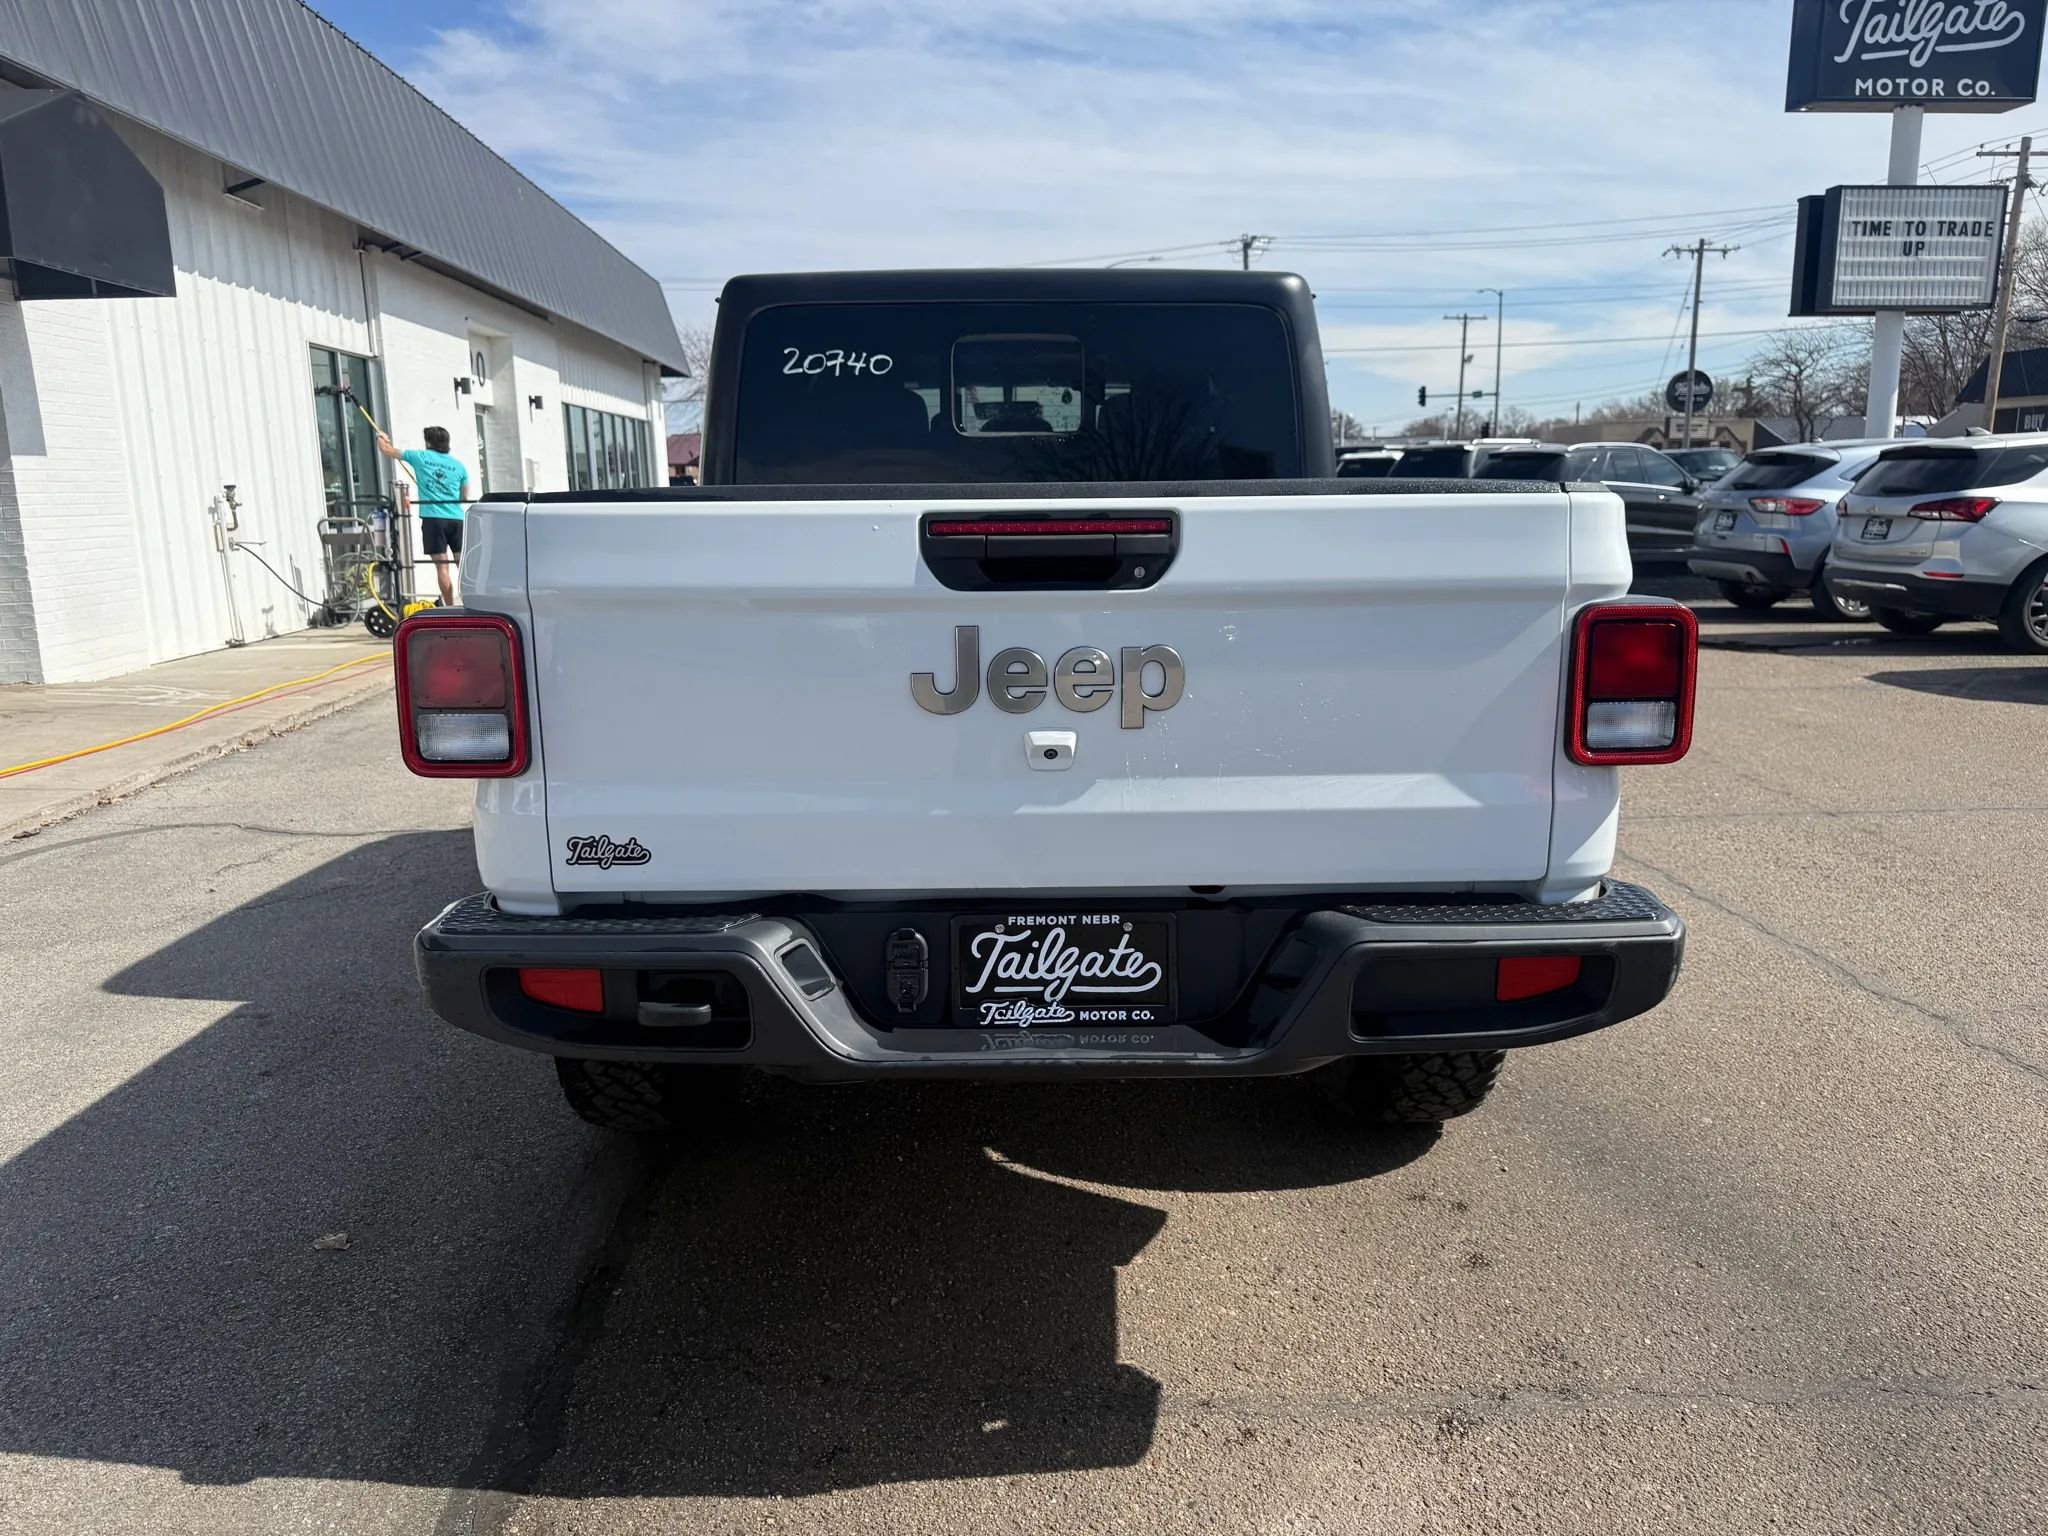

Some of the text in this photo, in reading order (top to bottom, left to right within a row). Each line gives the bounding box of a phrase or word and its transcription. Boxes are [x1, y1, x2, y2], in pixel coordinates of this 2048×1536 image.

[1834, 0, 2025, 67] Tailgate
[1855, 78, 1945, 97] MOTOR
[1852, 220, 1994, 238] TIME TO TRADE
[1903, 241, 1925, 256] UP
[783, 347, 893, 377] 20740
[2024, 413, 2045, 430] BUY
[910, 625, 1185, 729] Jeep
[566, 834, 652, 870] Tailgate
[1008, 914, 1120, 926] FREMONT NEBR
[965, 927, 1162, 1002] Tailgate
[979, 999, 1155, 1028] Tailgate MOTOR CO.
